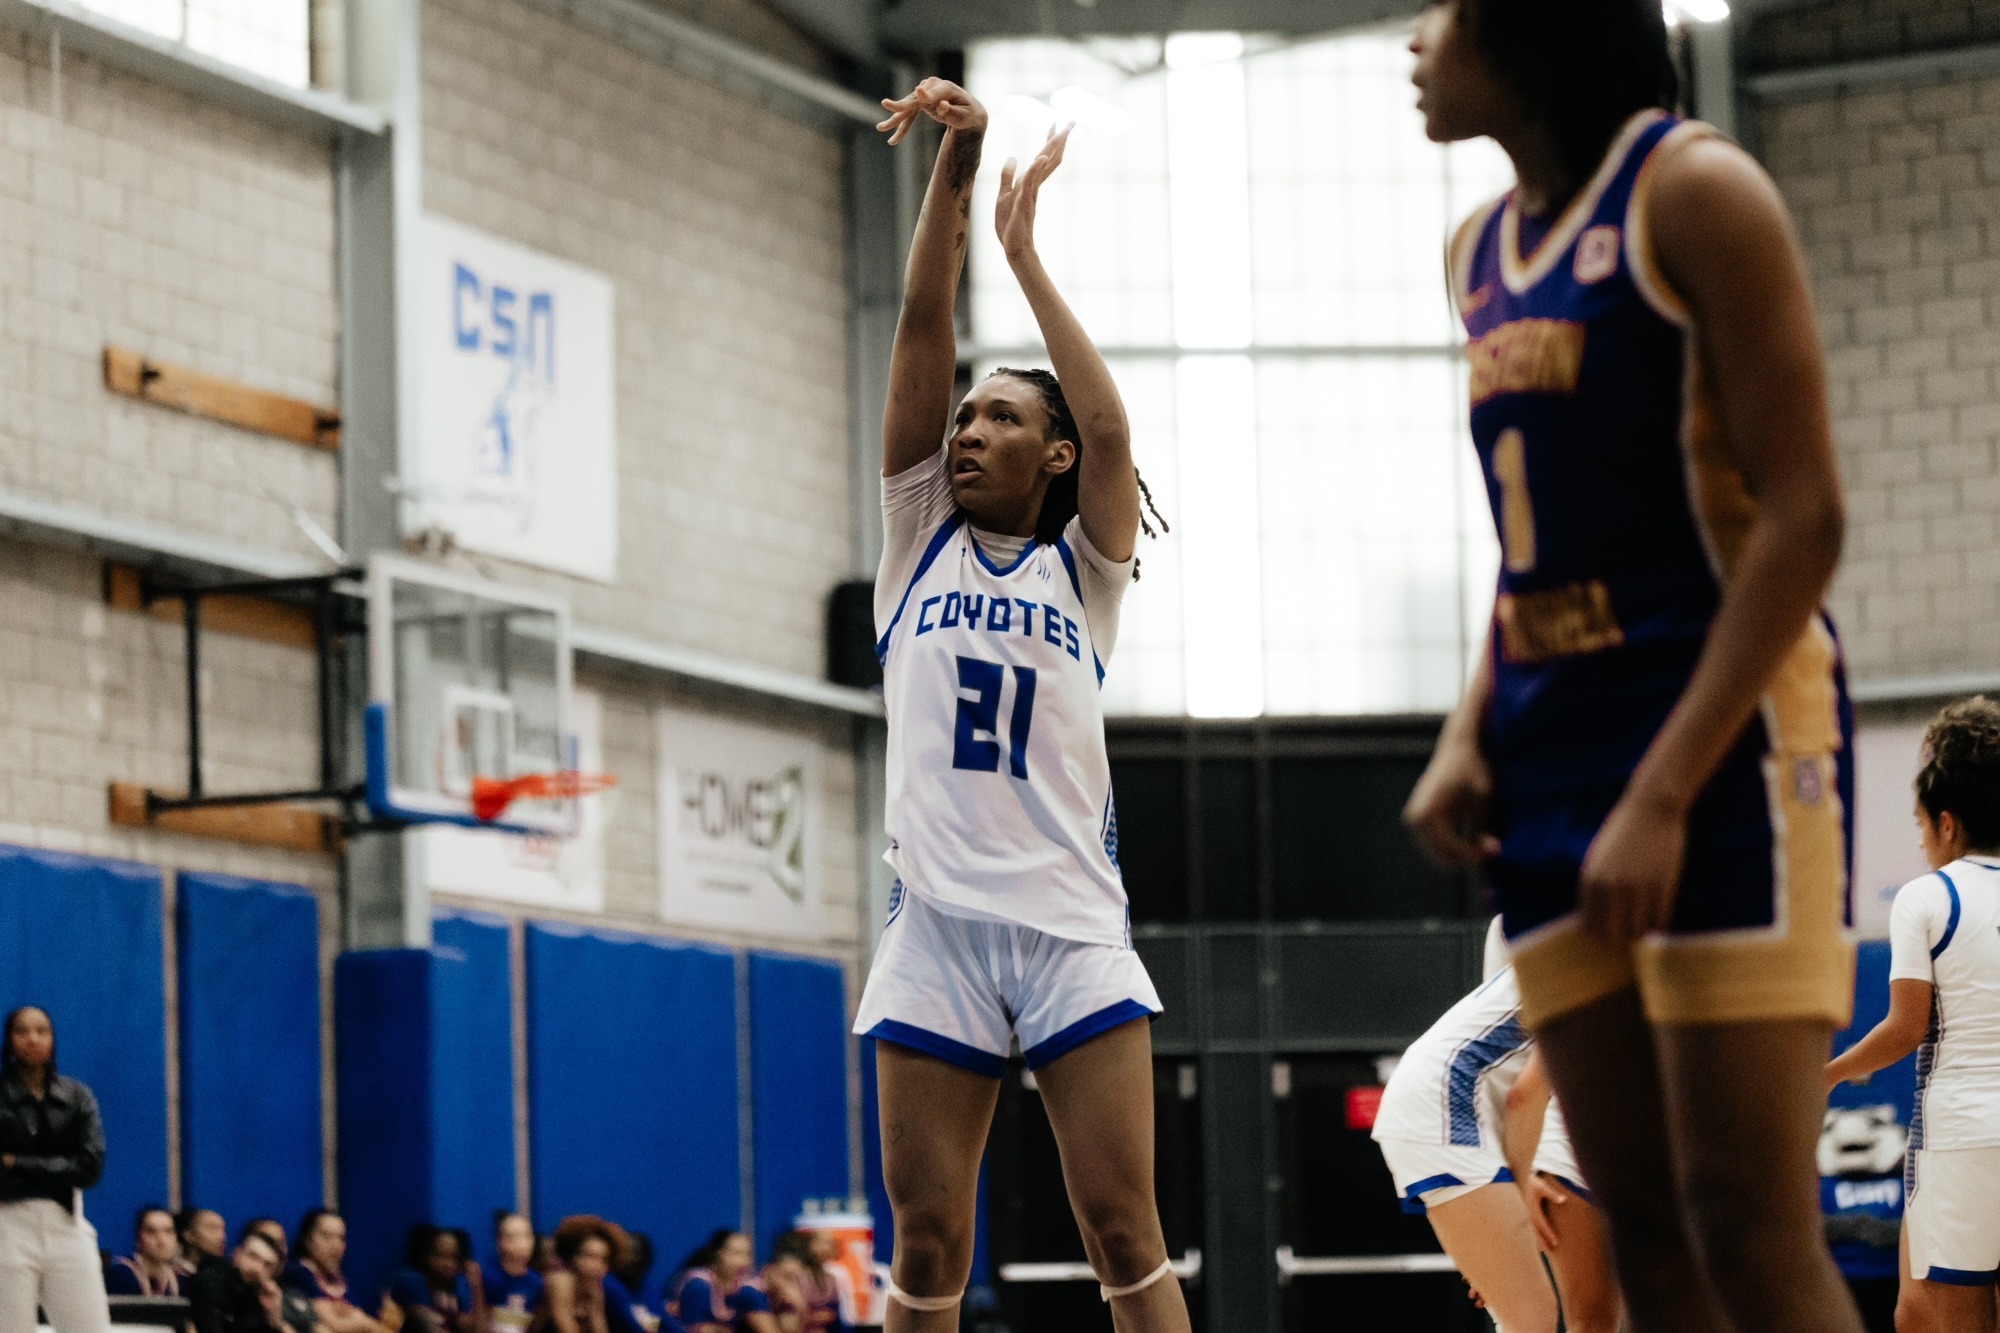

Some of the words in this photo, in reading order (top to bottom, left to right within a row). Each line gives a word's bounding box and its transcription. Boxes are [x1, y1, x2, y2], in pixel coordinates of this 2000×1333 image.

[1493, 426, 1538, 574] 1
[914, 590, 1081, 663] COYOTES
[952, 654, 1037, 781] 21
